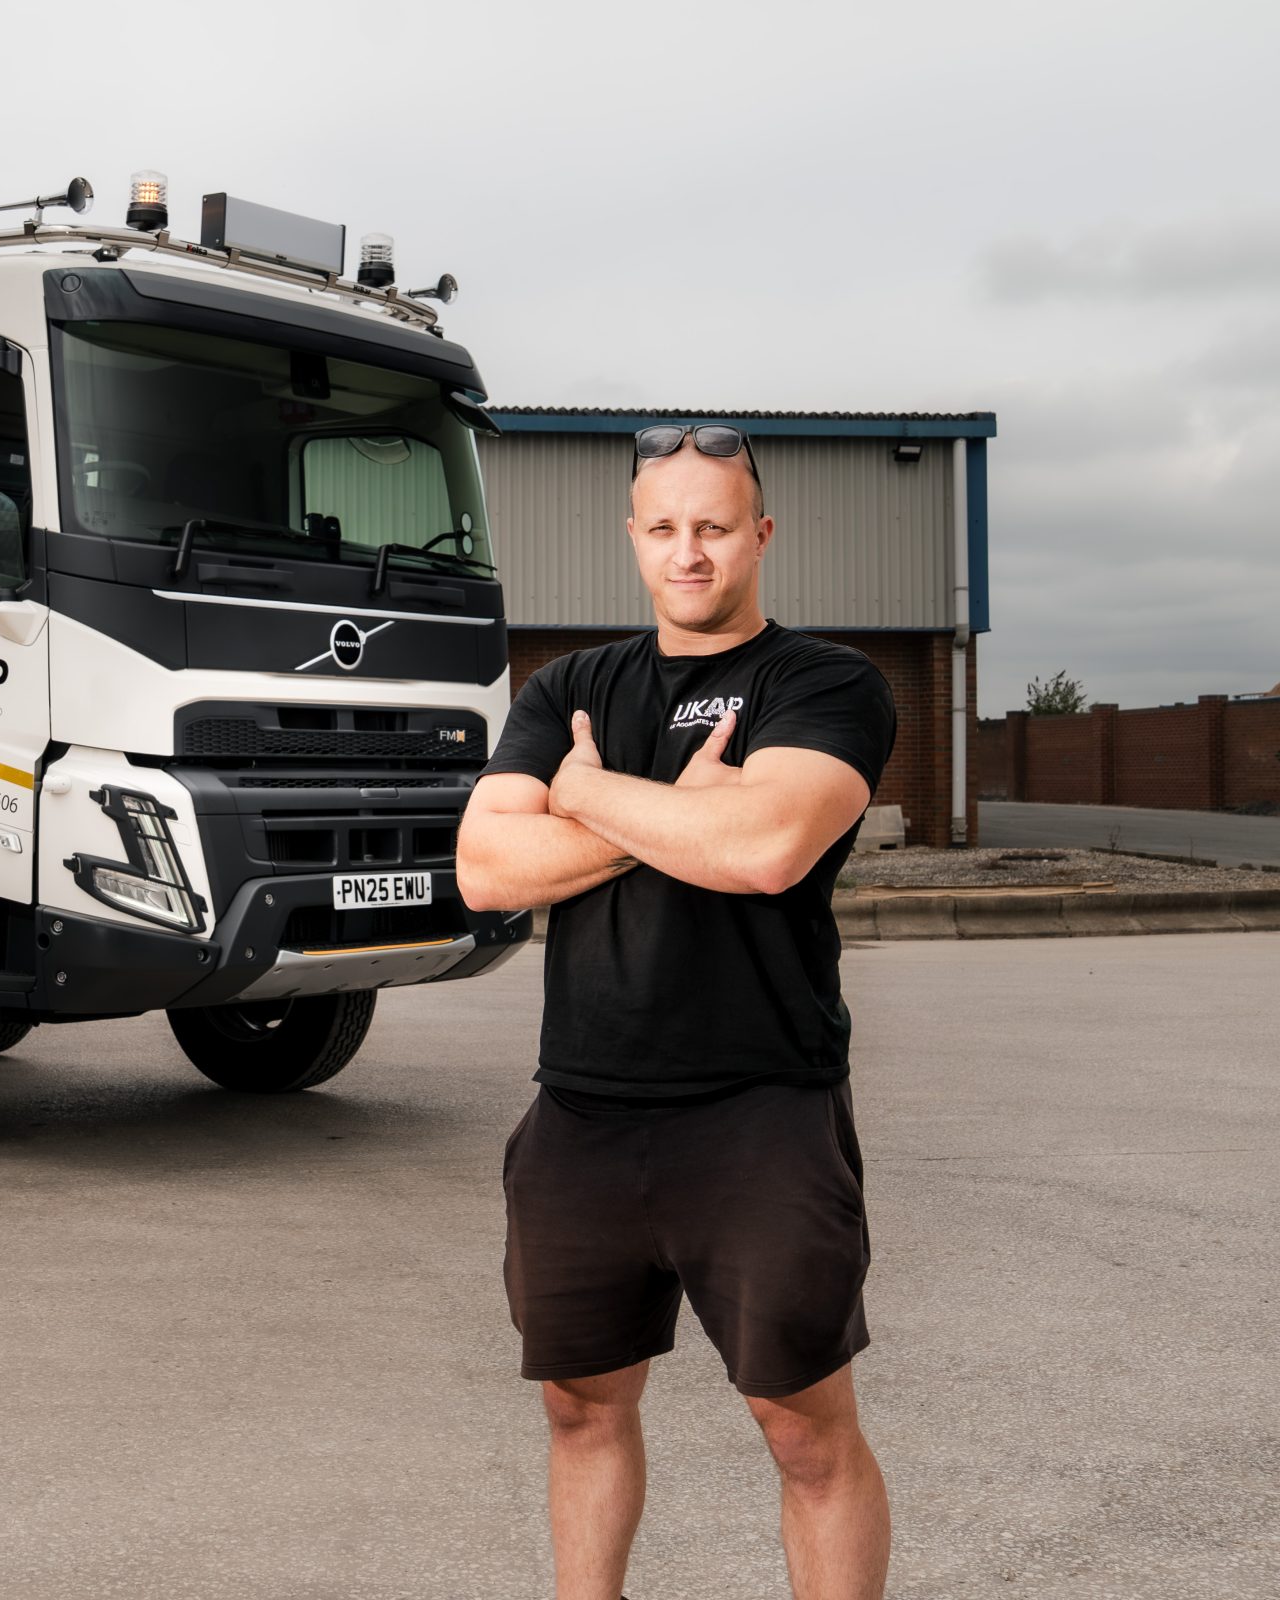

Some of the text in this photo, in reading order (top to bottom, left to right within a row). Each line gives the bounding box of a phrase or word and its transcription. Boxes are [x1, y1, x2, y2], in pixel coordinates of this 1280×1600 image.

[335, 640, 360, 649] VOLVO
[673, 696, 743, 722] UKAP
[341, 876, 425, 904] PN25 EWU
